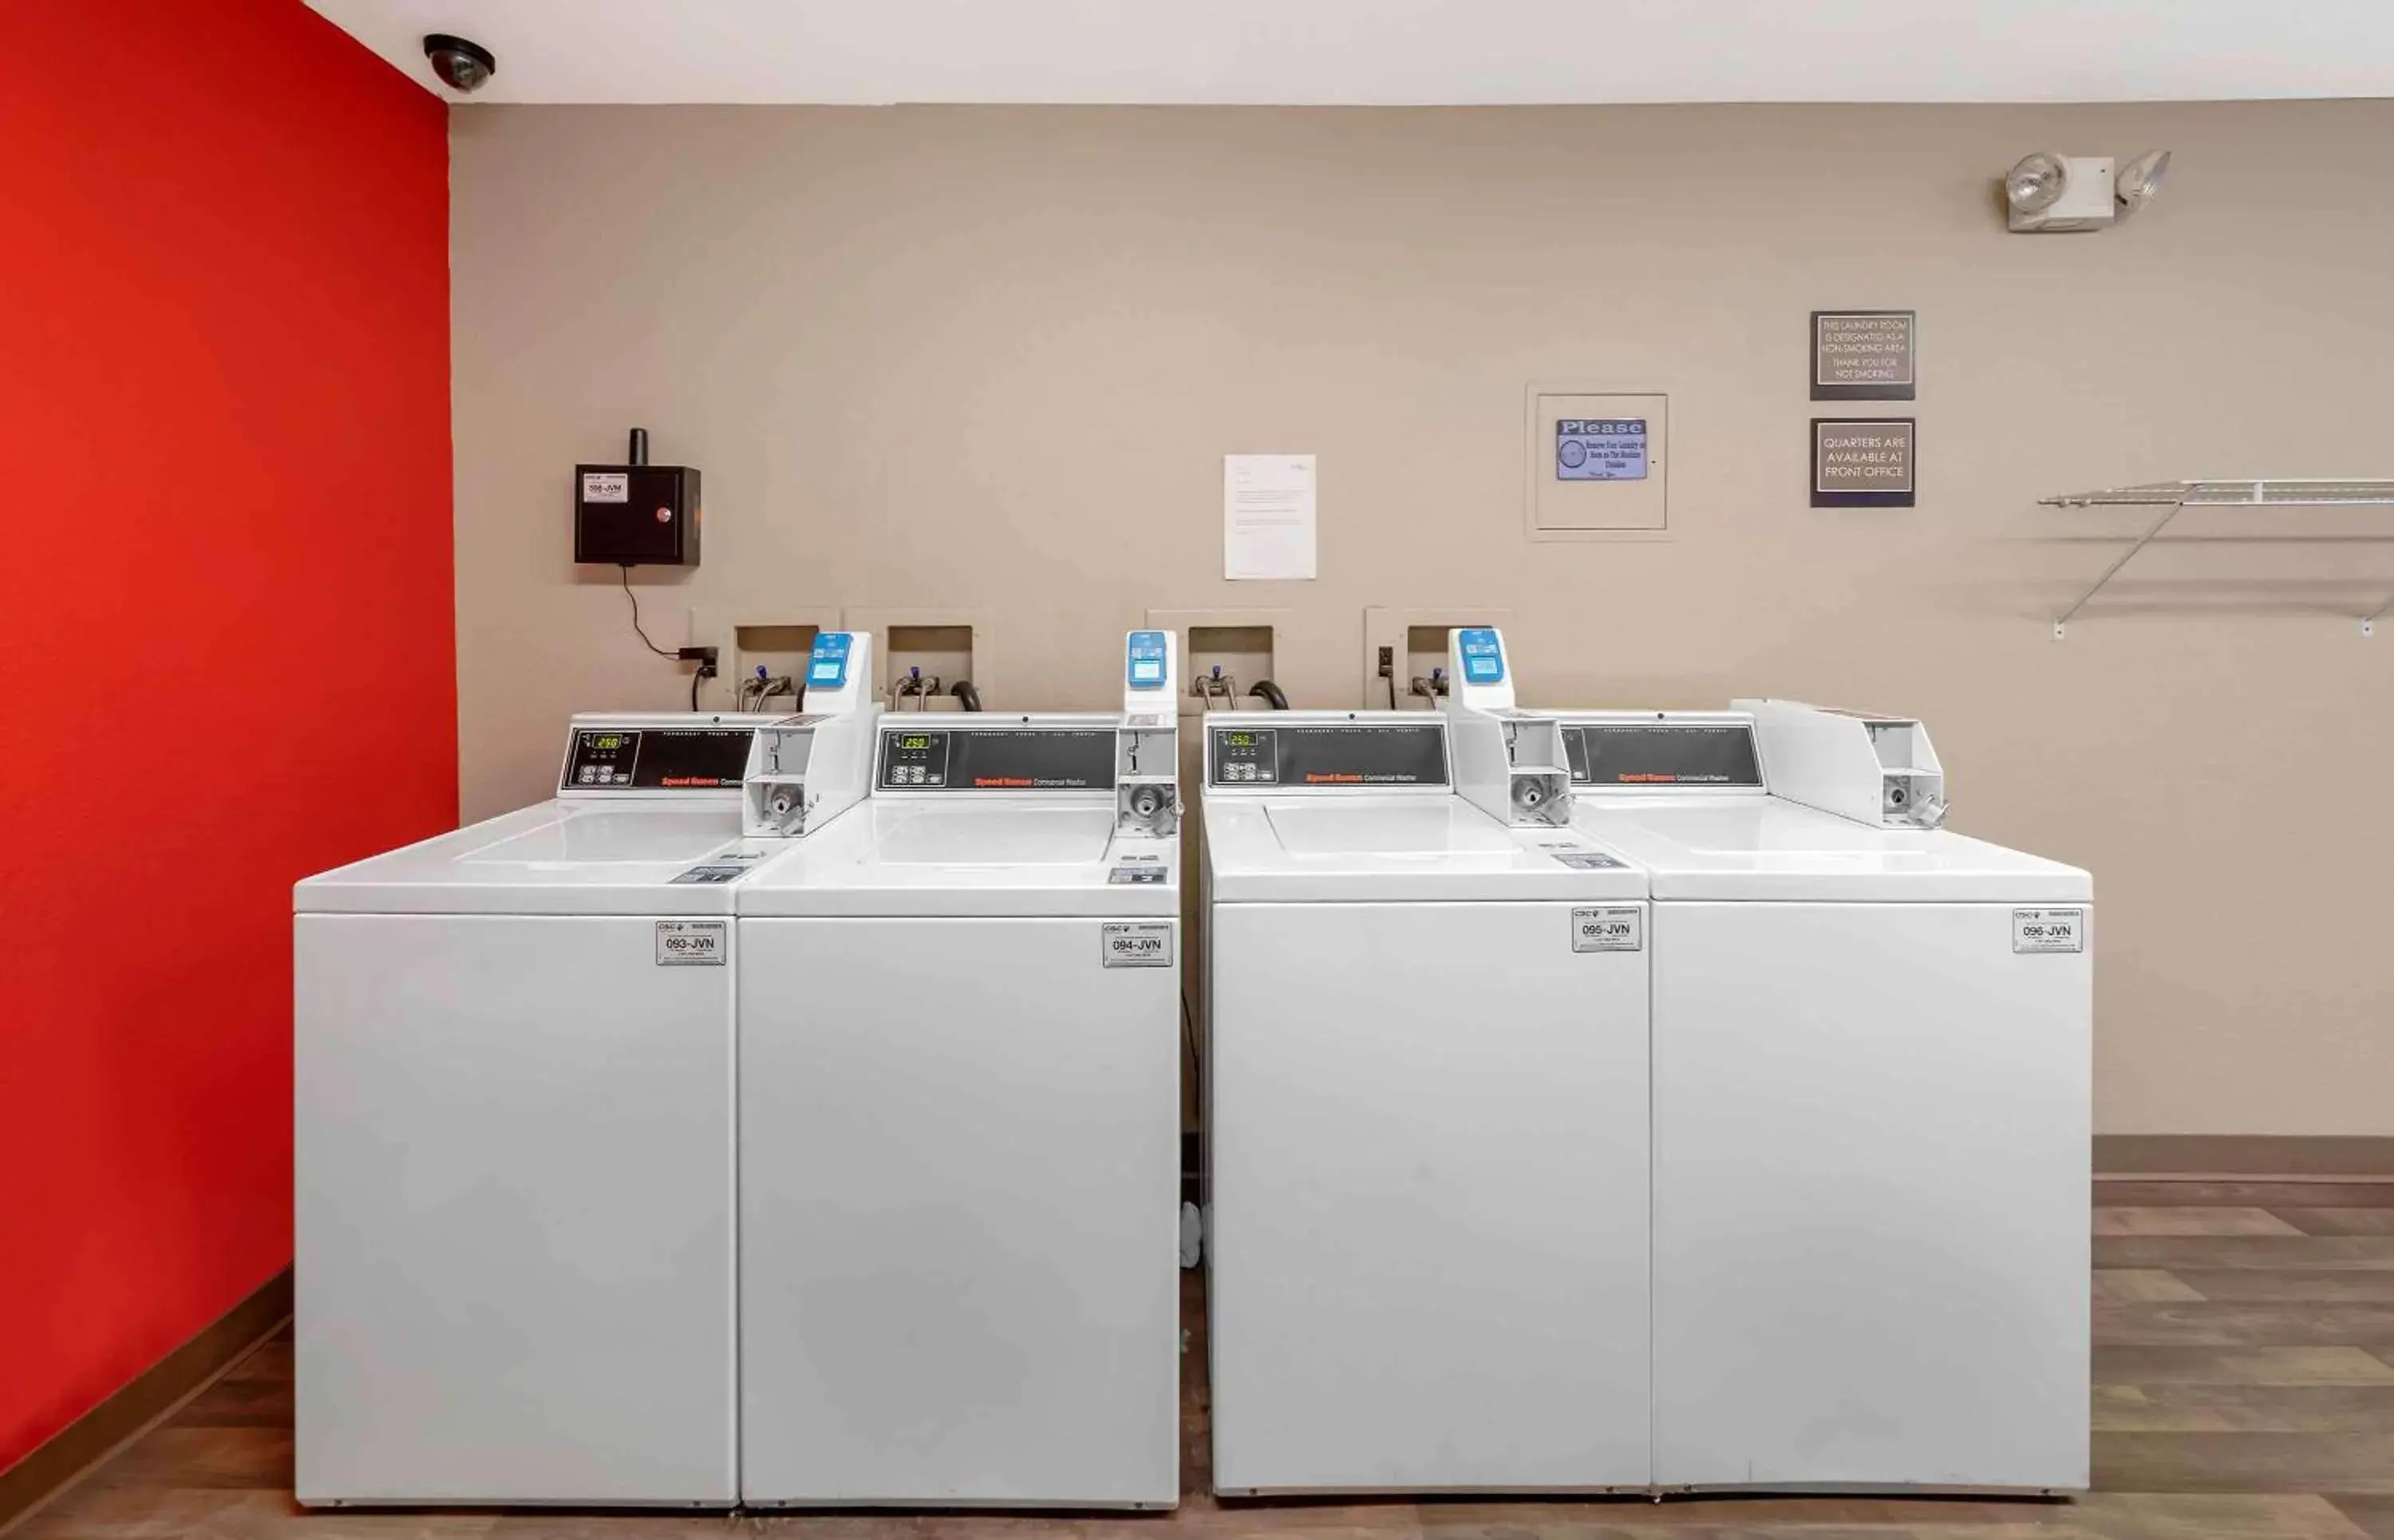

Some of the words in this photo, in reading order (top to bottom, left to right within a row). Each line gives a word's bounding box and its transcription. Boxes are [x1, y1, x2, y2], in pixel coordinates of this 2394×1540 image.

[1841, 321, 1878, 330] LAUNDRY
[1880, 320, 1906, 330] ROOM
[1834, 333, 1884, 342] DESIGNATED
[1833, 357, 1860, 367] THANK
[1862, 357, 1879, 367] YOU
[1835, 369, 1852, 379] NOT
[1854, 369, 1894, 379] SMOKING
[1562, 421, 1642, 434] Please
[1823, 437, 1882, 448] QUARTERS
[1883, 437, 1906, 448] ARE
[1827, 452, 1887, 462] AVAILABLE
[1889, 452, 1903, 462] AT
[1825, 467, 1862, 477] FRONT
[1864, 467, 1903, 477] OFFICE
[662, 776, 690, 787] Speed
[1582, 924, 1630, 934] 095-JVN
[2023, 926, 2072, 936] 096-JVN
[666, 938, 714, 948] 093-JVN
[1113, 939, 1161, 950] 094-JVN
